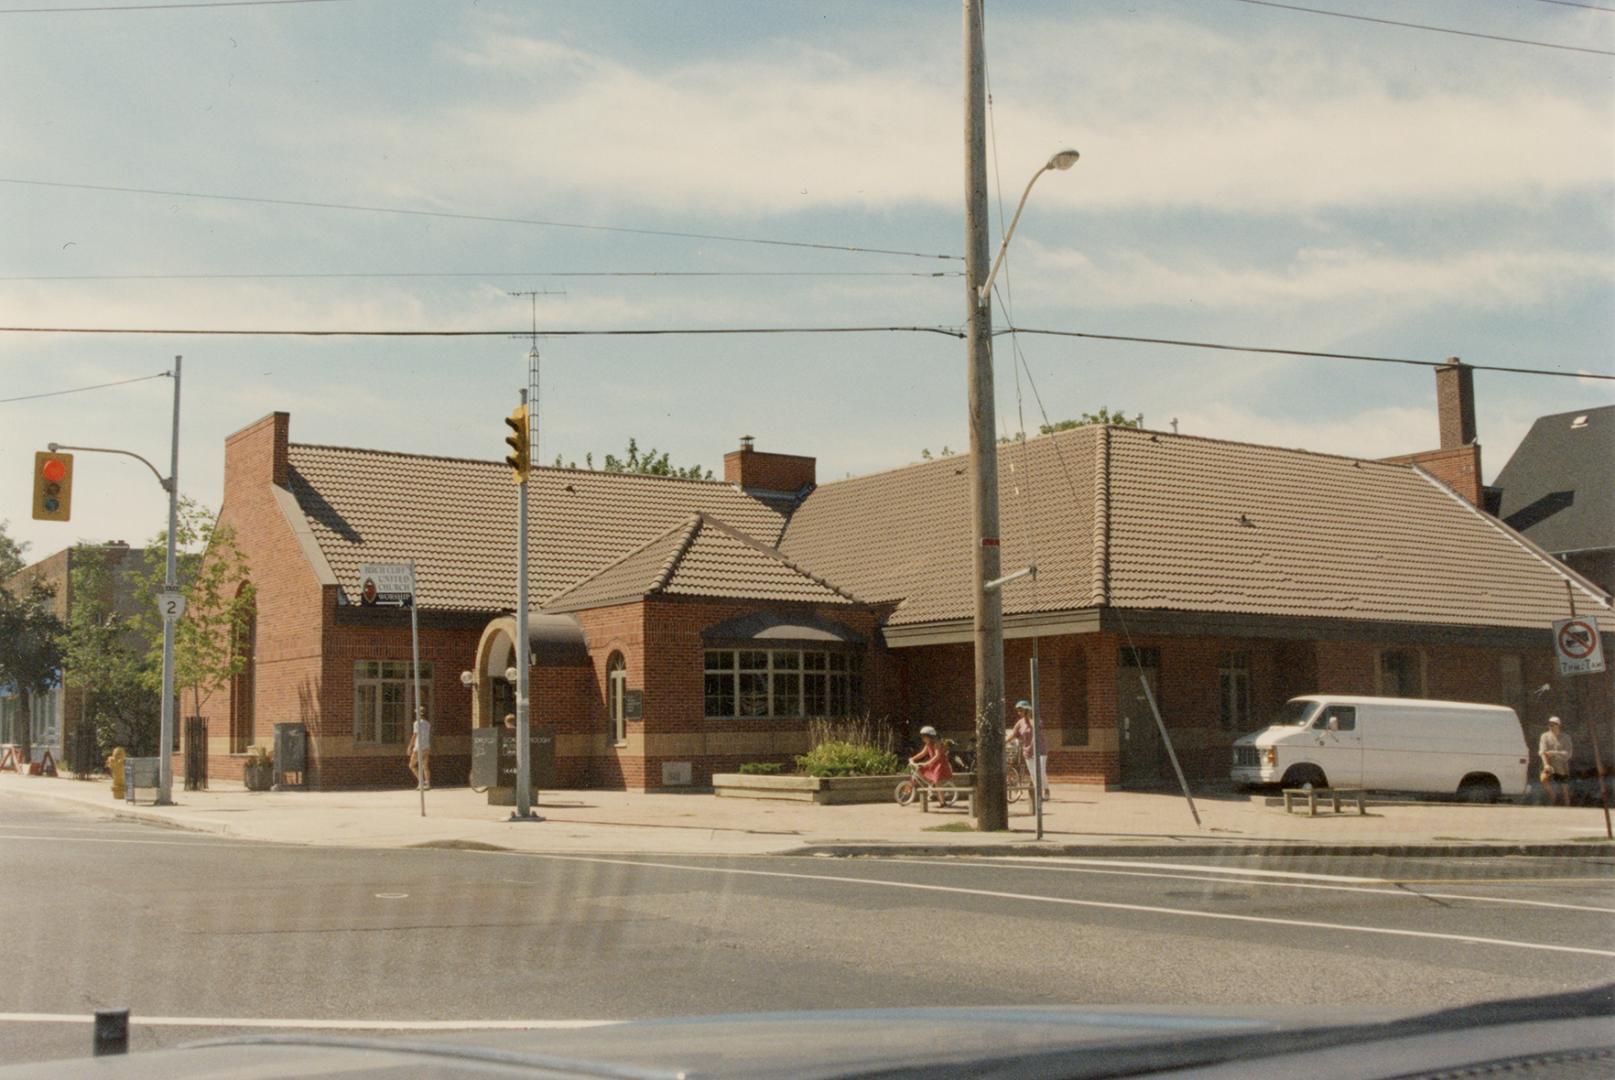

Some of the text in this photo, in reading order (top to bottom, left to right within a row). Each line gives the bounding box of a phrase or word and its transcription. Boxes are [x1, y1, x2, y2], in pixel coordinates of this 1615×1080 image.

[378, 583, 410, 591] CHURCH
[378, 593, 411, 601] WORSHIP
[167, 600, 177, 615] 2
